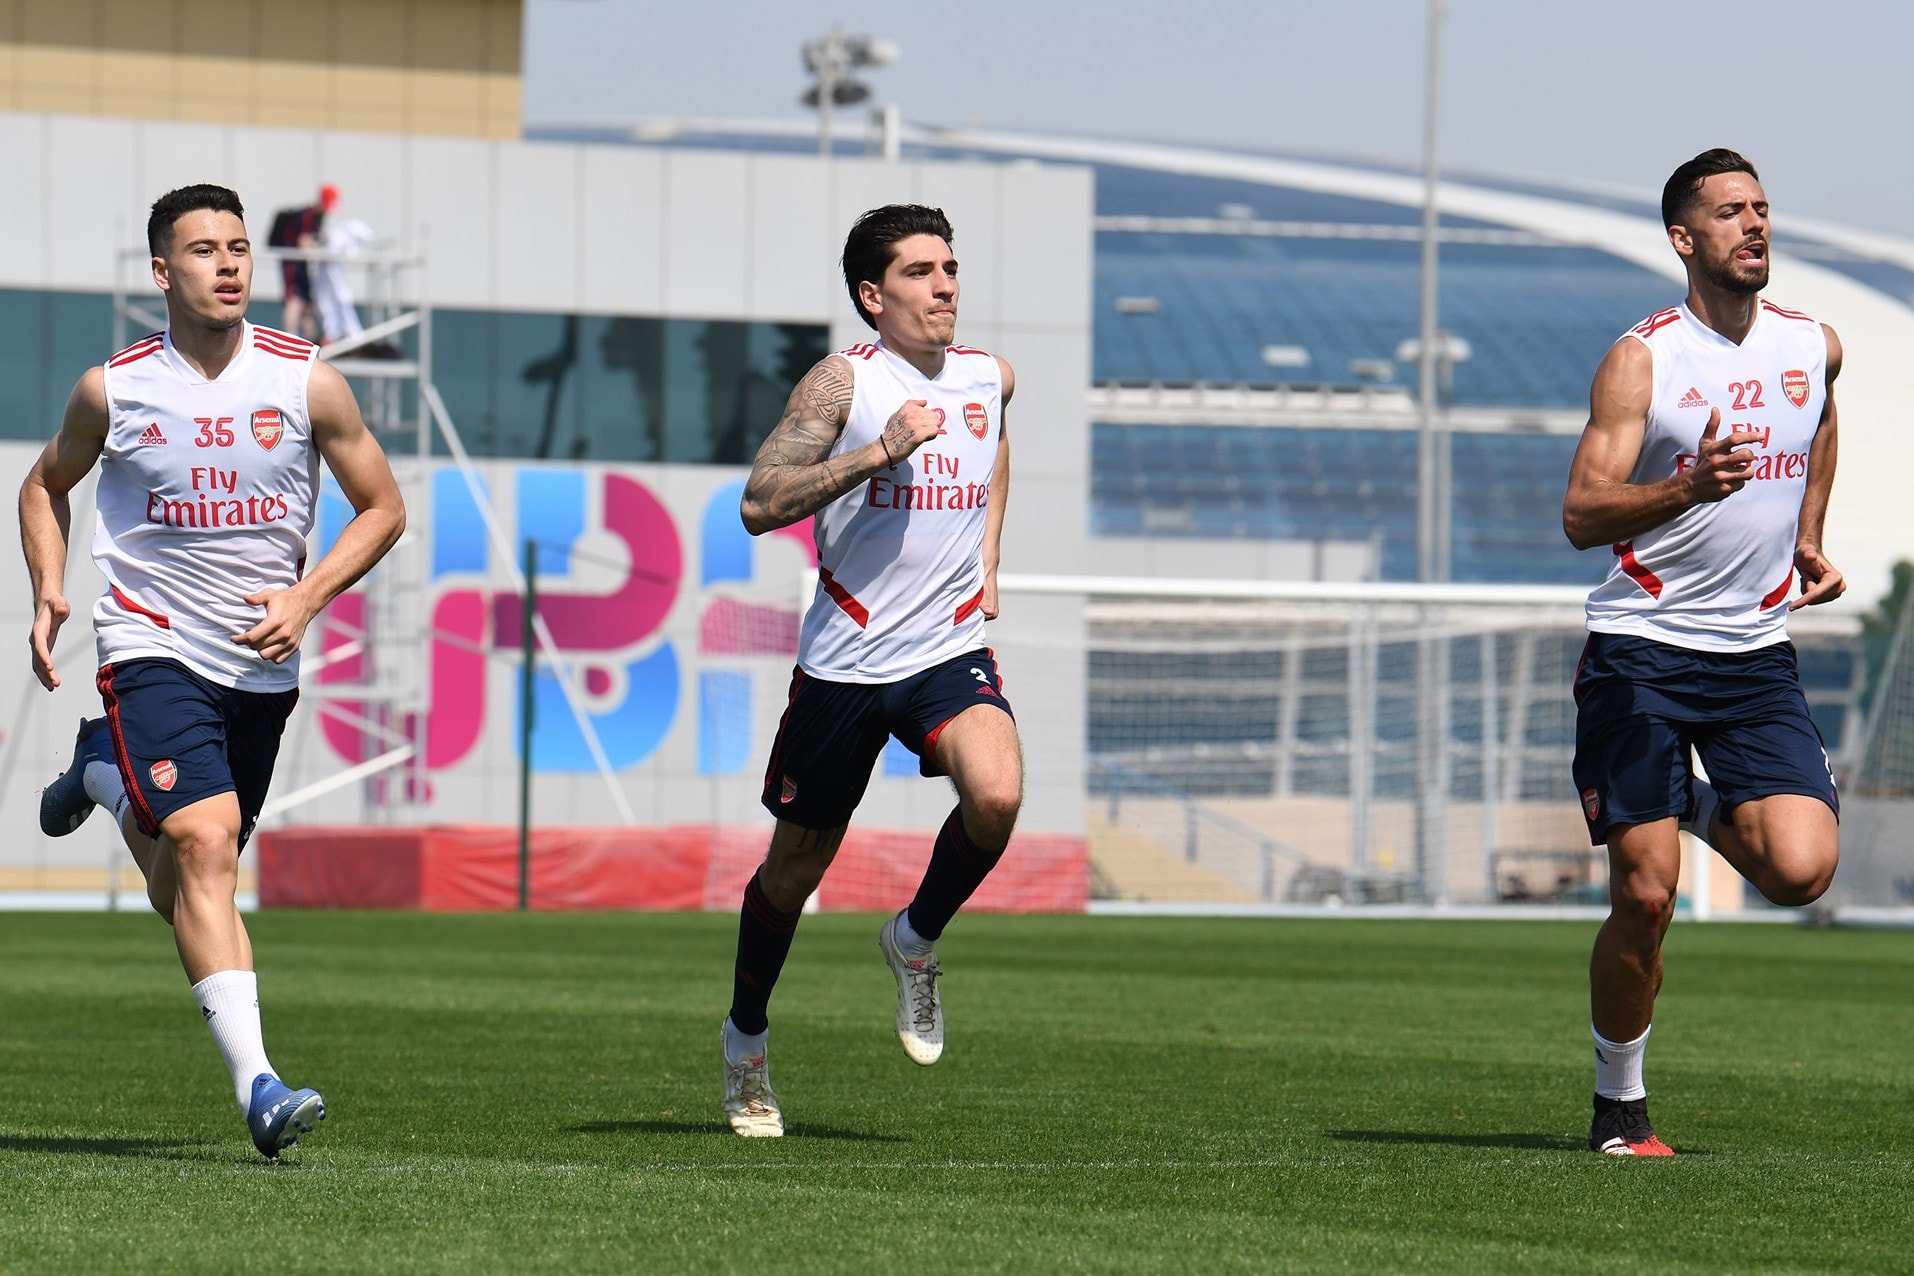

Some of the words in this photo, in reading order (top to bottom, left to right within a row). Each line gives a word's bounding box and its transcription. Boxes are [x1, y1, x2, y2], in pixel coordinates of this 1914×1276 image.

[1677, 399, 1709, 408] adidas
[1728, 380, 1765, 410] 22
[138, 436, 168, 445] adidas
[194, 417, 235, 448] 35
[190, 466, 237, 494] Fly
[922, 453, 959, 479] Fly
[869, 476, 990, 510] Emirate
[146, 490, 288, 528] Emirates
[969, 667, 992, 685] 2
